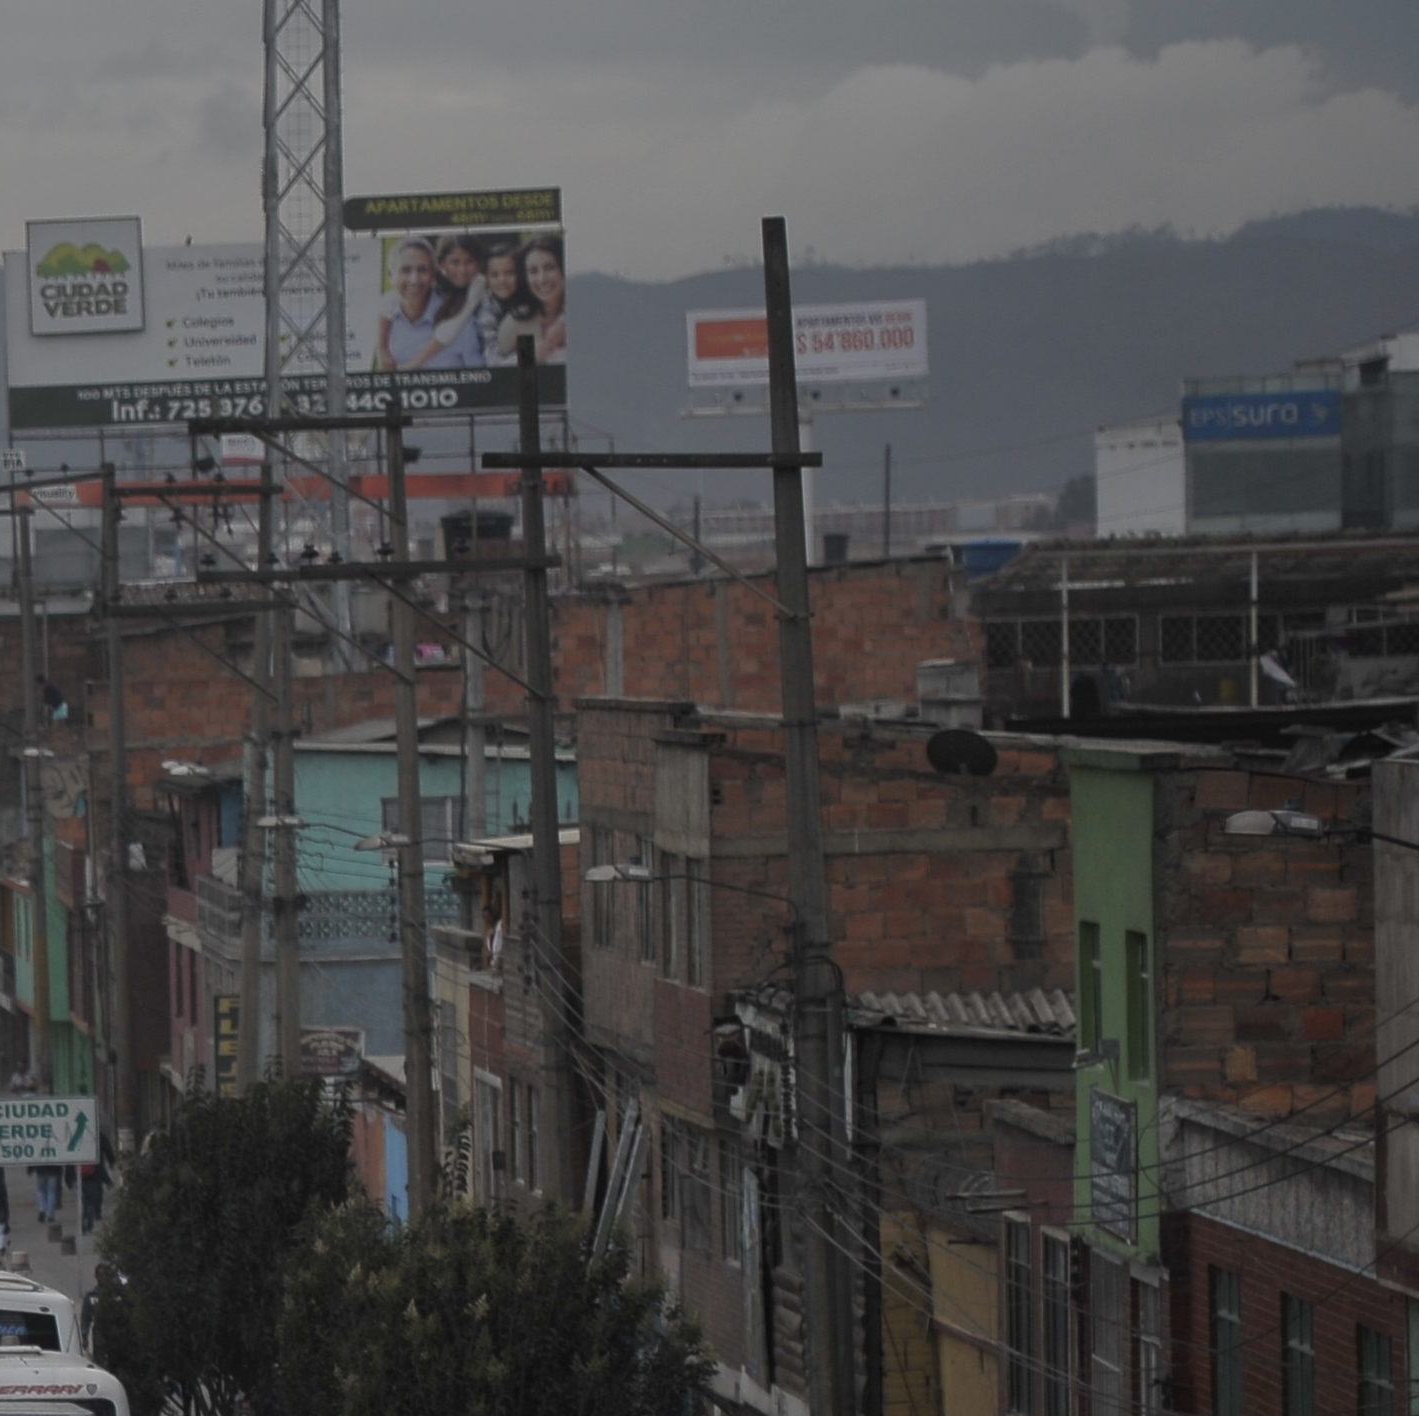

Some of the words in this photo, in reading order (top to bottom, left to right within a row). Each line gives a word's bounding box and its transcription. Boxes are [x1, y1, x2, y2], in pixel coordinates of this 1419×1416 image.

[365, 194, 499, 216] APARTAMENTOS
[501, 191, 554, 208] DESDE
[40, 281, 129, 301] CIUDAD
[43, 298, 129, 319] VERDE
[183, 315, 235, 330] Colegios
[183, 334, 257, 349] Universidad
[102, 387, 131, 400] MTS
[134, 381, 191, 399] DESPUÉS
[195, 383, 212, 396] DE
[215, 382, 231, 395] LA
[304, 376, 370, 391] TERROS
[374, 374, 392, 388] DE
[395, 369, 493, 387] TRANSMILENIO
[167, 398, 211, 421] 725
[400, 386, 459, 410] 1010
[1190, 407, 1228, 429] EPS
[1231, 401, 1299, 428] sura
[1, 1144, 35, 1159] 500
[40, 1146, 57, 1158] m
